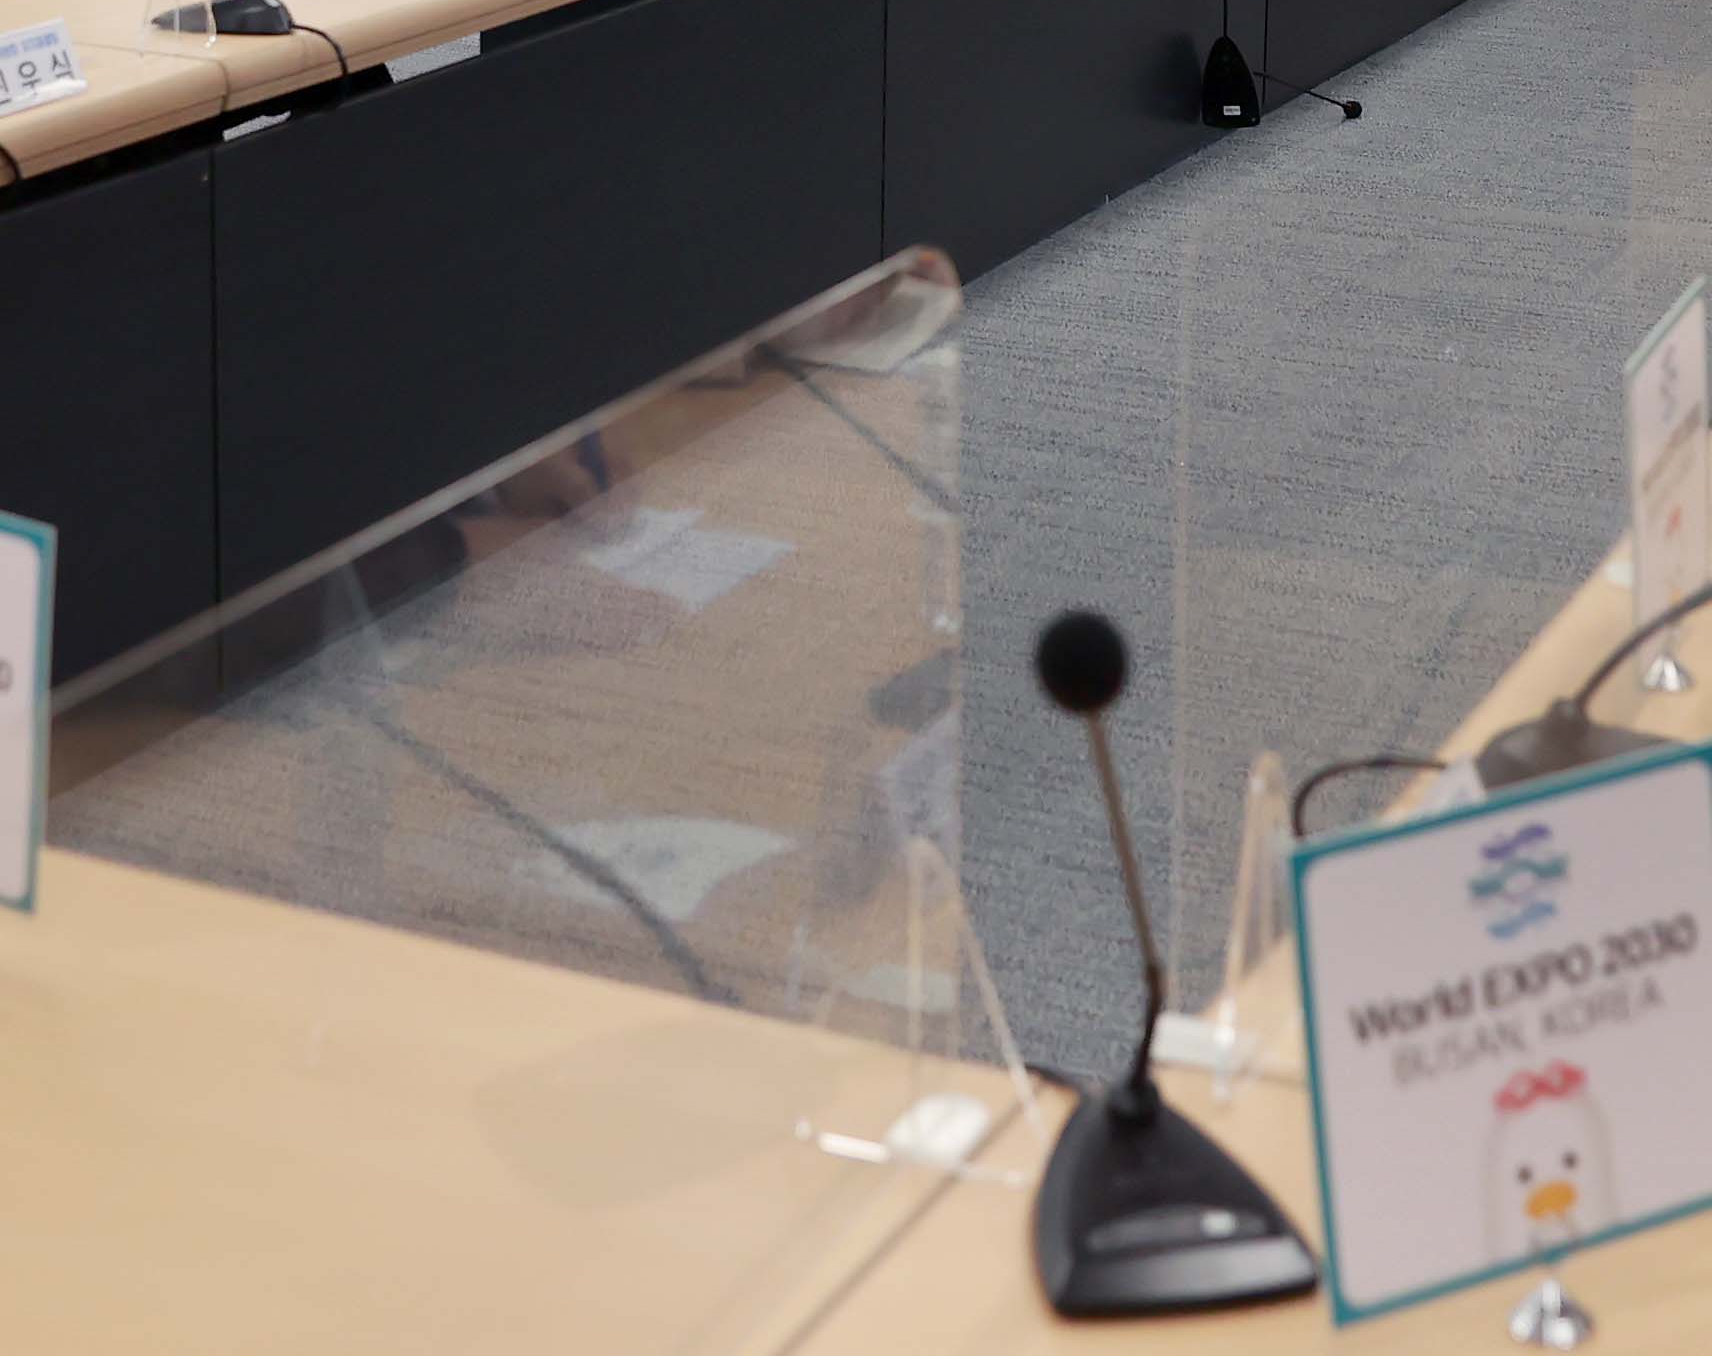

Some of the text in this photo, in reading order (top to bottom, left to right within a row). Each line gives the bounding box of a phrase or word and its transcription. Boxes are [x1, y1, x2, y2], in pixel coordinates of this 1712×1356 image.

[1350, 912, 1700, 1044] World EXPO 2030
